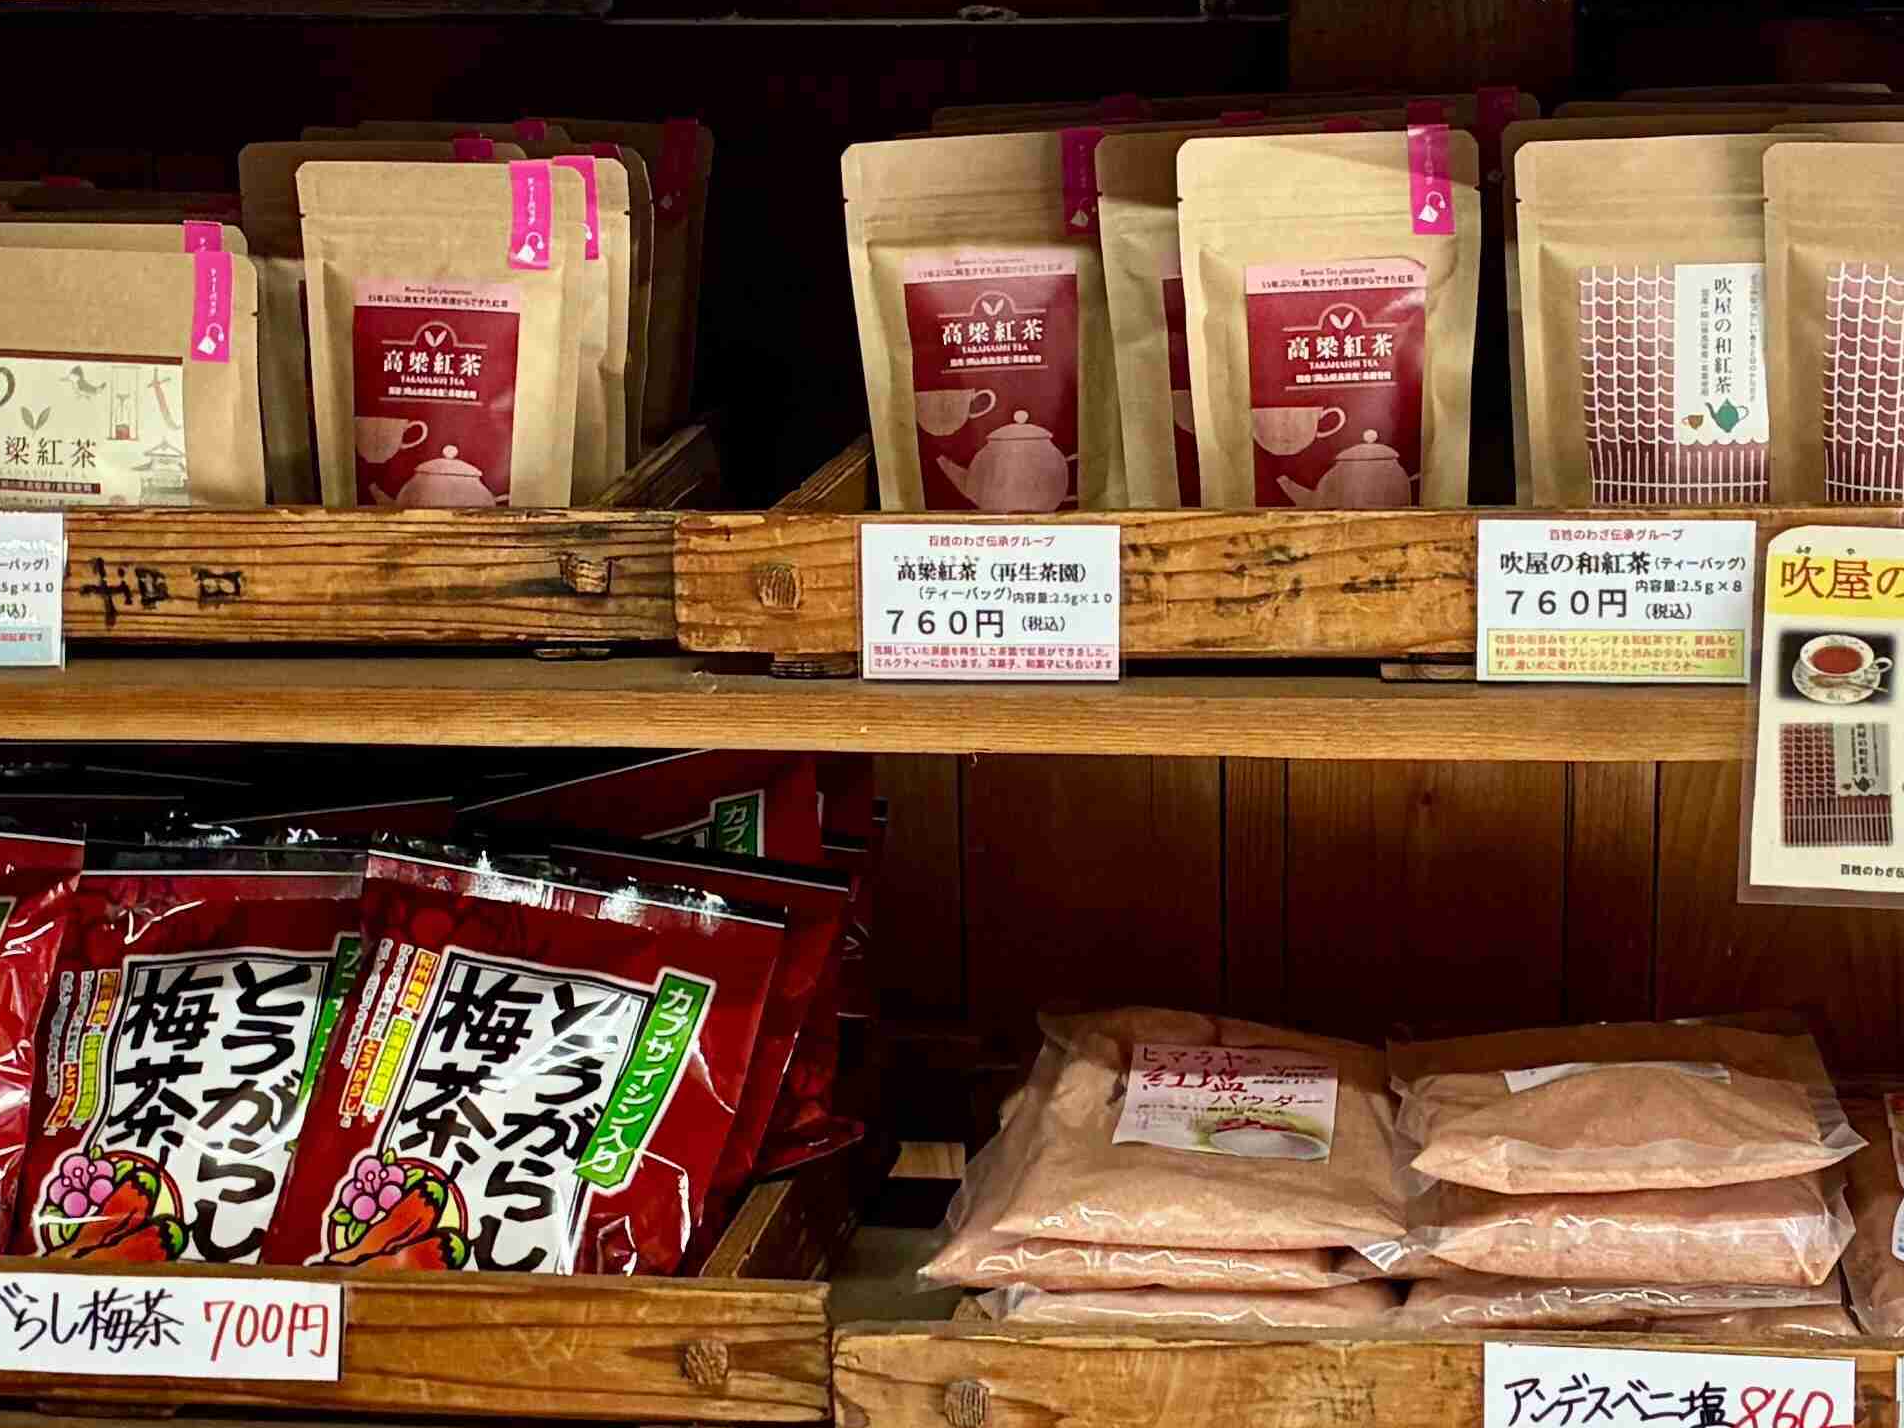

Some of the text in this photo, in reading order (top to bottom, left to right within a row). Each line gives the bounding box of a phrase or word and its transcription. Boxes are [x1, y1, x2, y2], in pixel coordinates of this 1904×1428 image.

[942, 318, 1044, 346] 高梁紅茶
[1287, 332, 1393, 361] 高梁紅茶
[1713, 277, 1733, 396] 吹屋の和紅茶
[383, 349, 483, 377] 高梁紅茶
[1549, 528, 1684, 542] 百姓のわざ伝承グループ
[1499, 550, 1746, 576] 吹屋の和紅茶 (ティーバッグ)
[918, 586, 1012, 602] (ティーバッグ)
[1505, 588, 1628, 619] 760円
[885, 609, 1067, 639] 760円 (税込)
[1644, 603, 1693, 621] (税込)
[721, 802, 751, 856] カプ
[105, 971, 219, 1149] 梅茶
[401, 968, 543, 1164] 梅茶
[584, 986, 695, 1176] カプサイシン入り
[1142, 1064, 1248, 1093] 紅塩
[189, 962, 312, 1262] とうがらし
[1211, 1094, 1324, 1108] パウダー
[473, 982, 632, 1271] とうがらし
[203, 1299, 330, 1362] 700円
